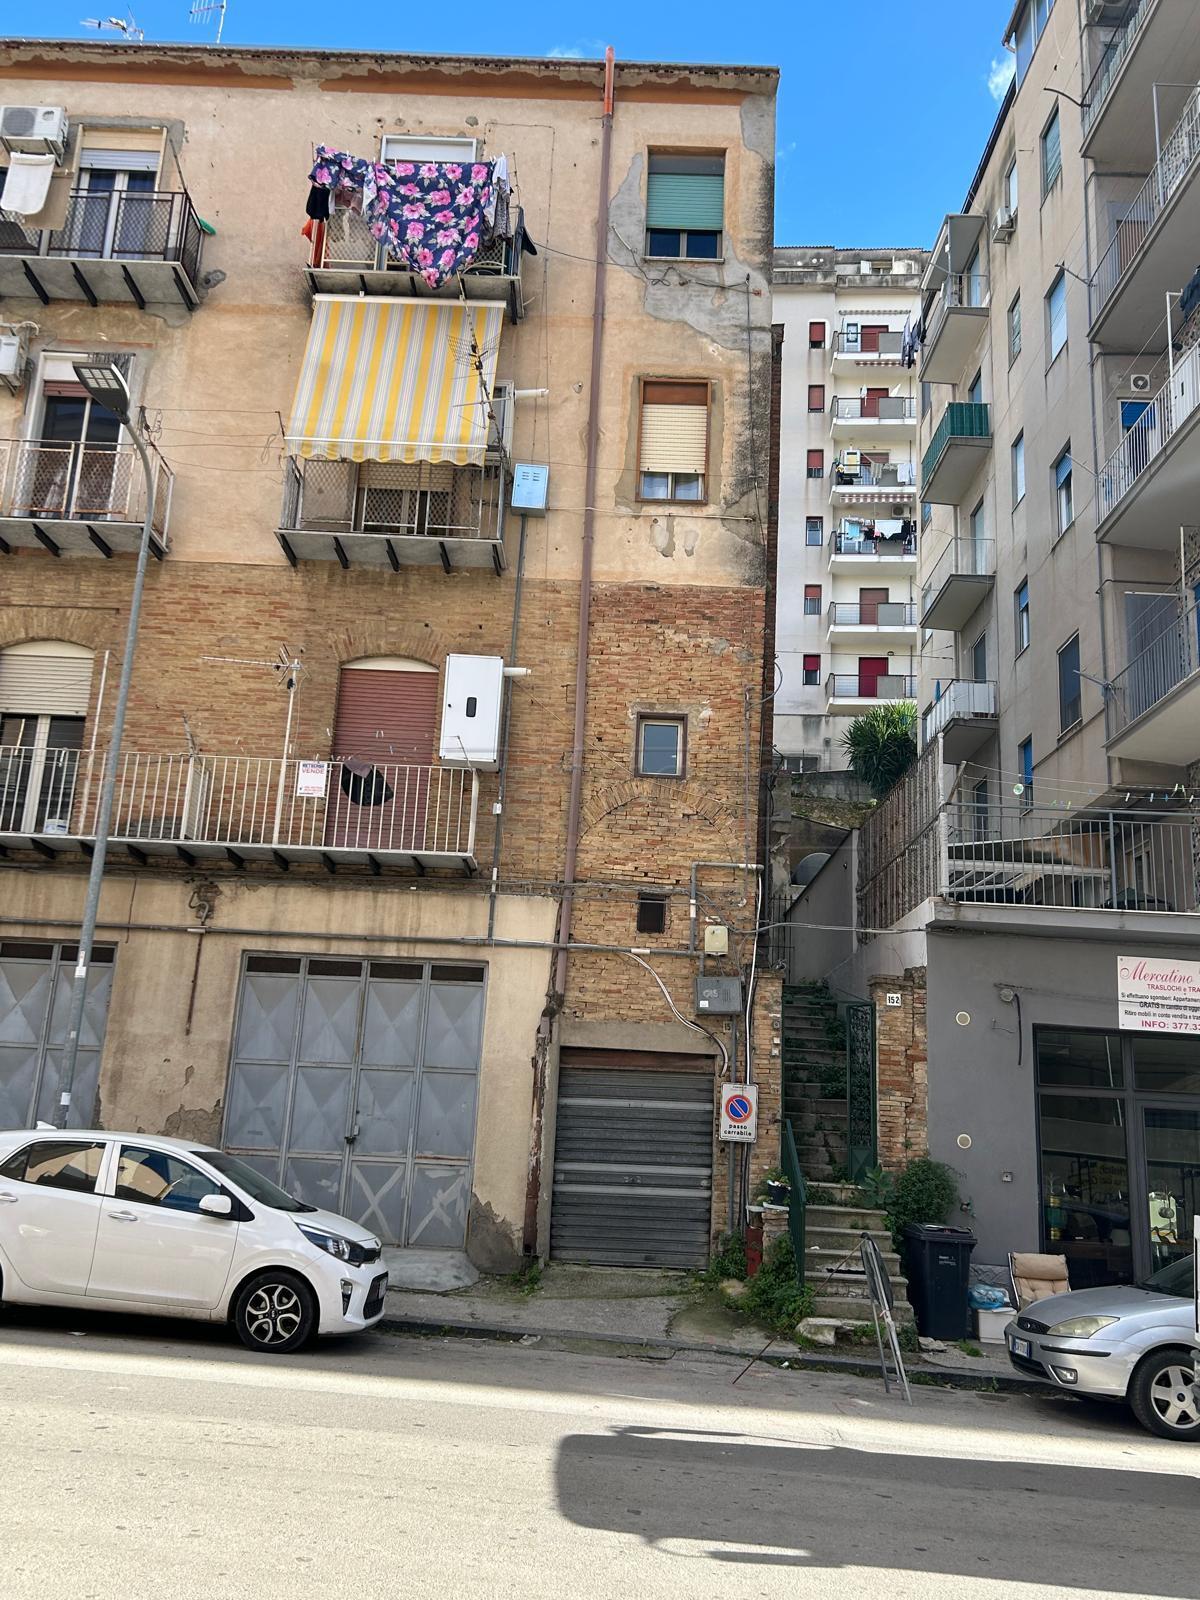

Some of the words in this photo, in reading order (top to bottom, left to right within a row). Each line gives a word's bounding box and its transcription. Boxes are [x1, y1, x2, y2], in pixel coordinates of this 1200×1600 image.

[1120, 961, 1193, 984] Mercatino
[1147, 983, 1182, 992] TRASLOCHI
[888, 995, 900, 1004] 152
[1141, 1020, 1169, 1028] INFO:
[723, 1129, 752, 1137] carrabile
